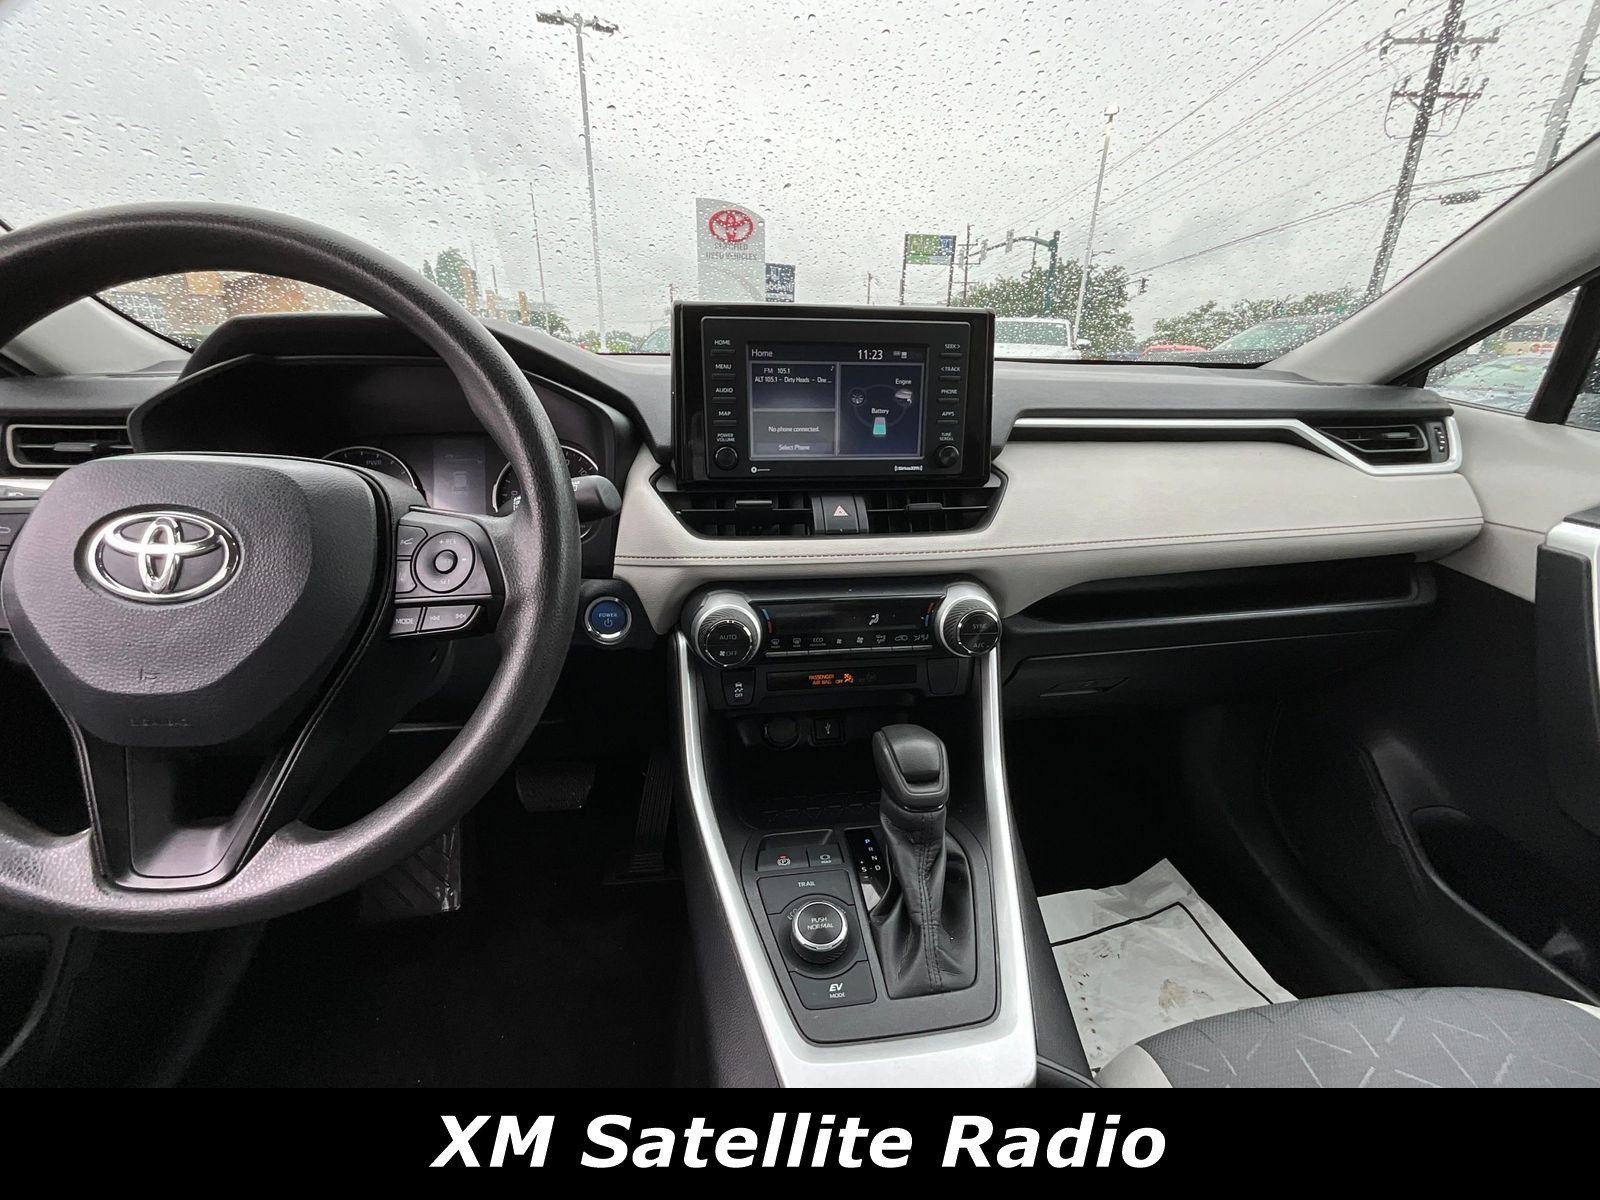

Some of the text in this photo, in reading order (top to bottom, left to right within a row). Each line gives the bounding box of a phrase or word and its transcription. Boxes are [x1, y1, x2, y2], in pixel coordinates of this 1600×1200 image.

[751, 348, 773, 358] Home
[857, 349, 883, 360] 11:23
[895, 378, 912, 386] Engine
[871, 407, 889, 416] Battery
[829, 982, 844, 992] EV
